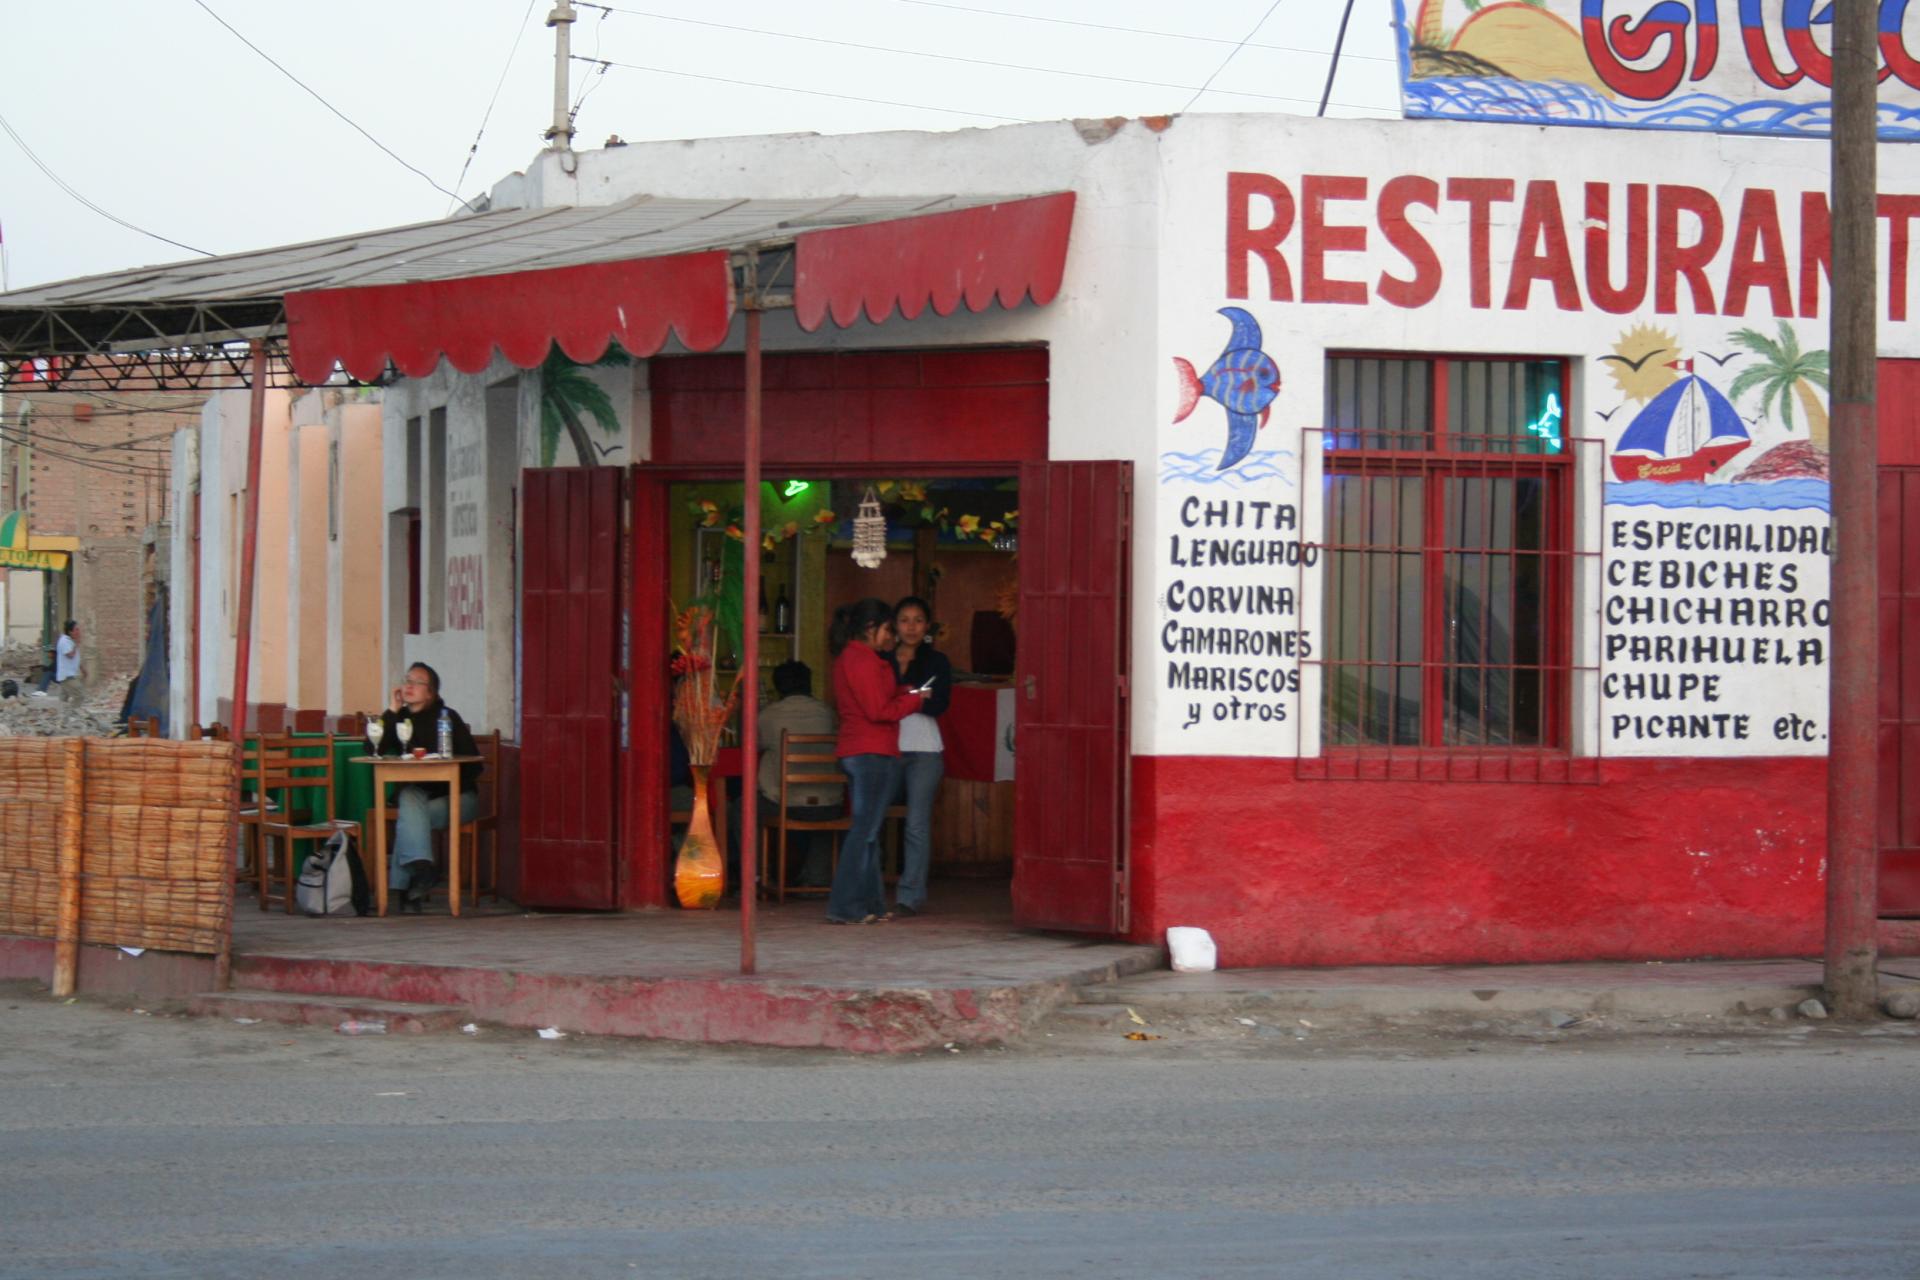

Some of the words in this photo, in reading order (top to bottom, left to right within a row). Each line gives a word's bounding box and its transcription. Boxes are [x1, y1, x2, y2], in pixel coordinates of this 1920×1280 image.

[1226, 172, 1920, 322] RESTAURANT
[1181, 496, 1296, 530] CHITA
[1170, 534, 1318, 567] LENGUADO
[1607, 559, 1798, 593] CEBICHES
[1167, 580, 1294, 615] CORVINA
[1161, 619, 1312, 657] CAMARONES
[1606, 634, 1824, 666] PARIHUELA
[1168, 661, 1300, 693] MARISCOS
[1602, 673, 1721, 702] CHUPE
[1182, 703, 1201, 730] y
[1213, 695, 1286, 722] otros
[1612, 714, 1750, 740] PICANTE
[1773, 713, 1828, 742] etc.
